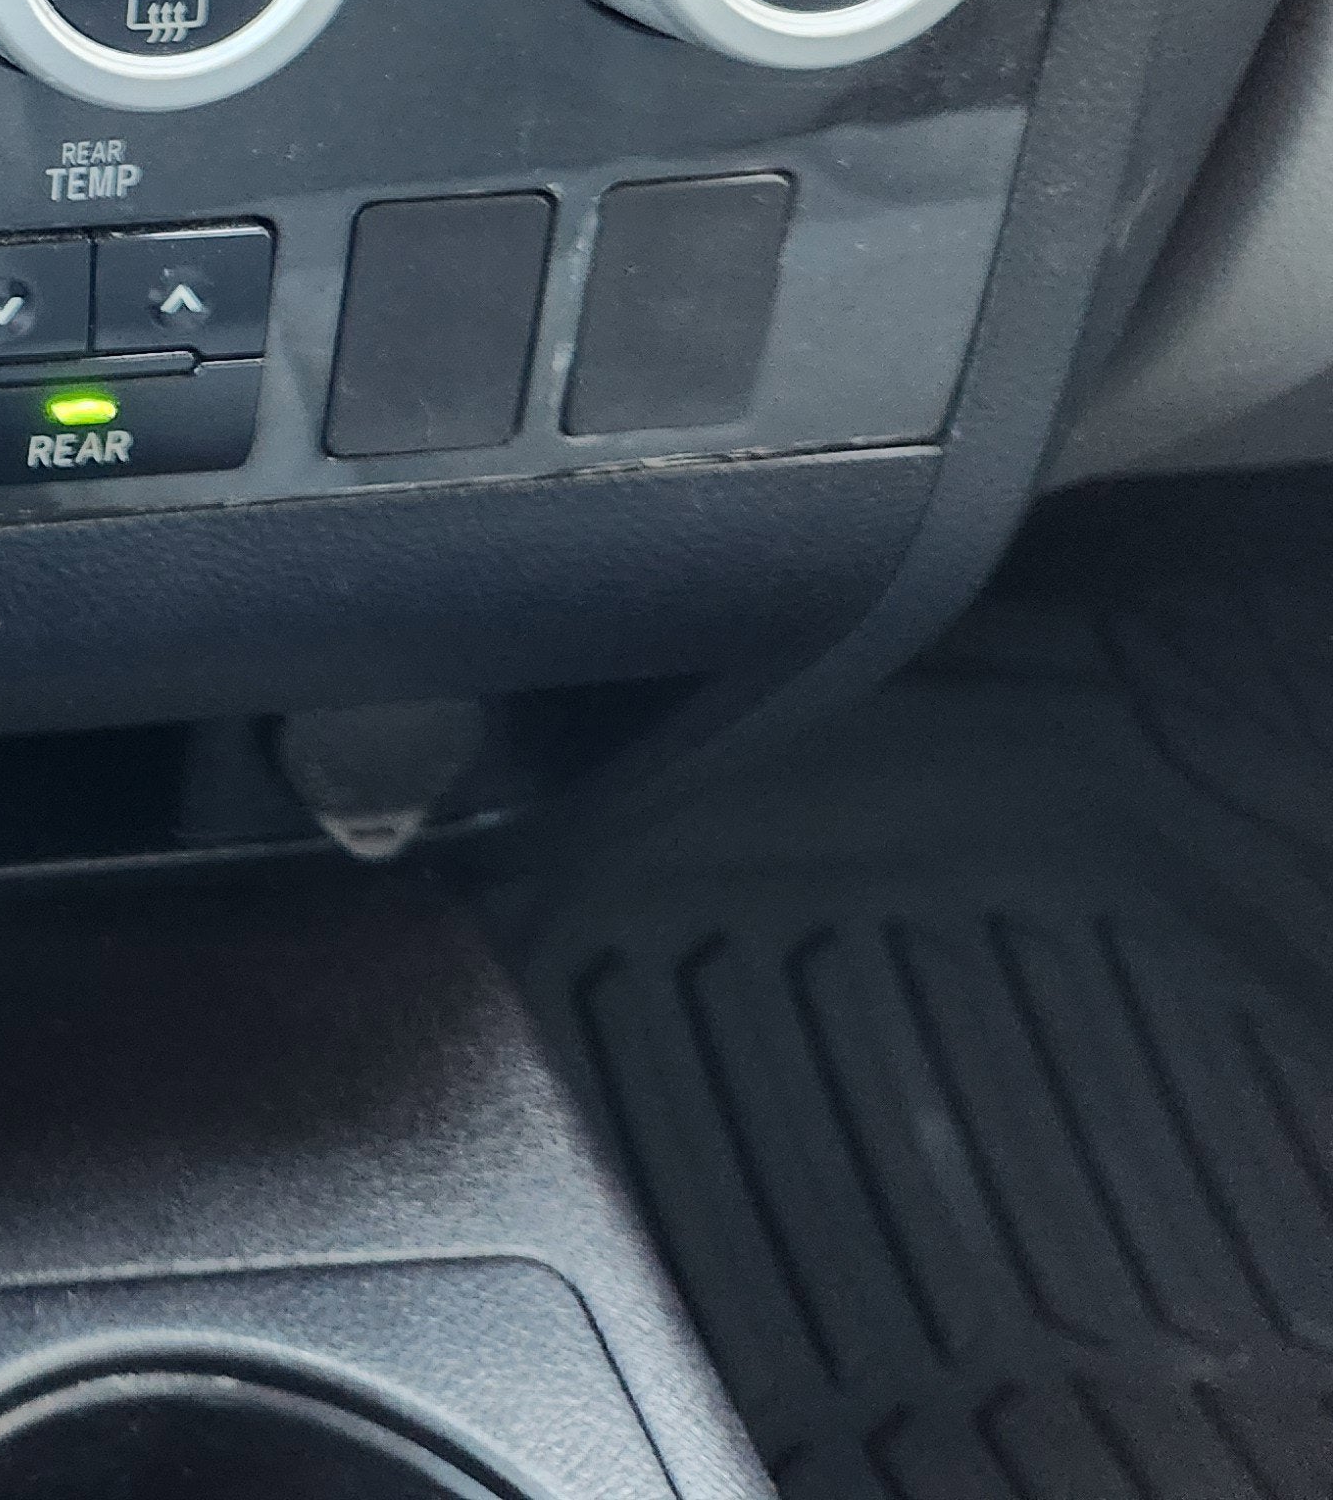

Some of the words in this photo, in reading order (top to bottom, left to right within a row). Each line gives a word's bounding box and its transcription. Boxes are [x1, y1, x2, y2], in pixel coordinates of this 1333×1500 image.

[61, 139, 126, 164] REAR
[45, 164, 141, 201] TEMP
[27, 430, 133, 468] REAR
